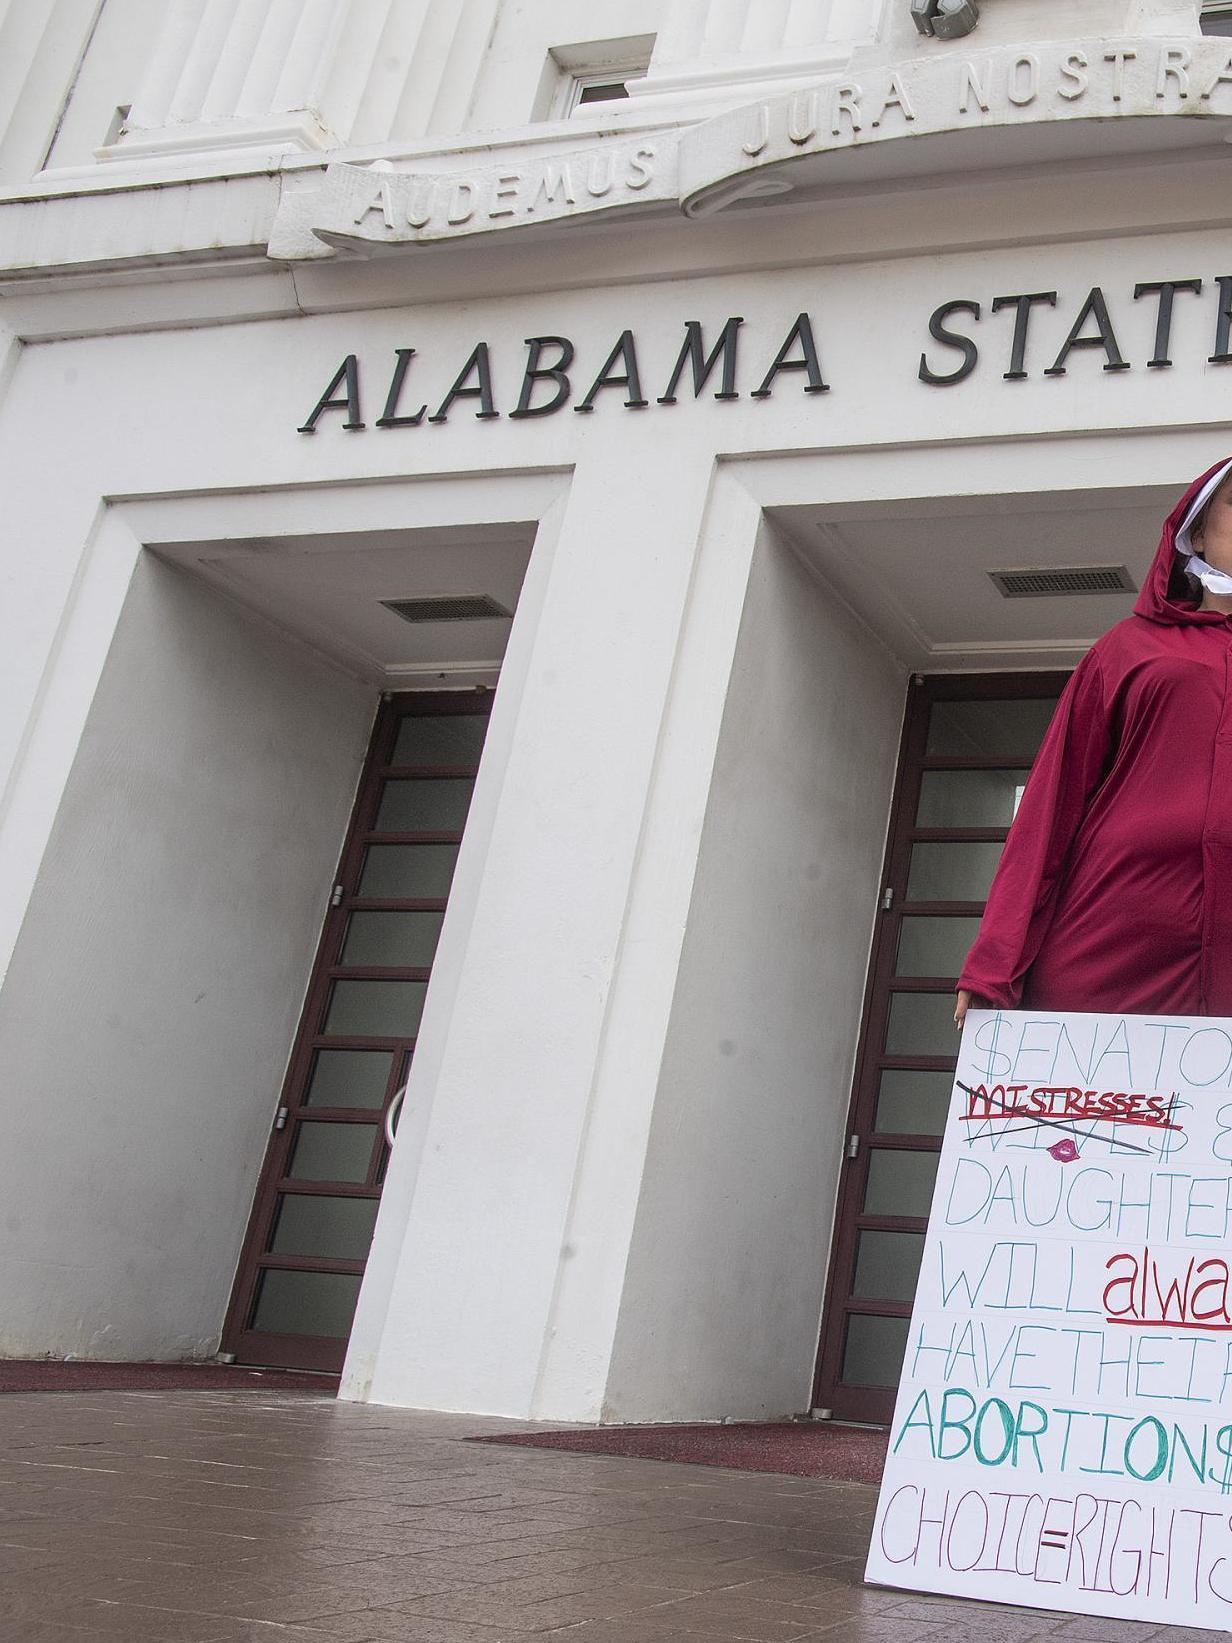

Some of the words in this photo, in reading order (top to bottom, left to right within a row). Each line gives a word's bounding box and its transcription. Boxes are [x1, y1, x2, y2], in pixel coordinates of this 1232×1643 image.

[354, 147, 656, 230] AUDEMUS
[741, 72, 916, 157] JURA
[296, 312, 832, 434] ALABAMA
[938, 1241, 1103, 1315] WILL
